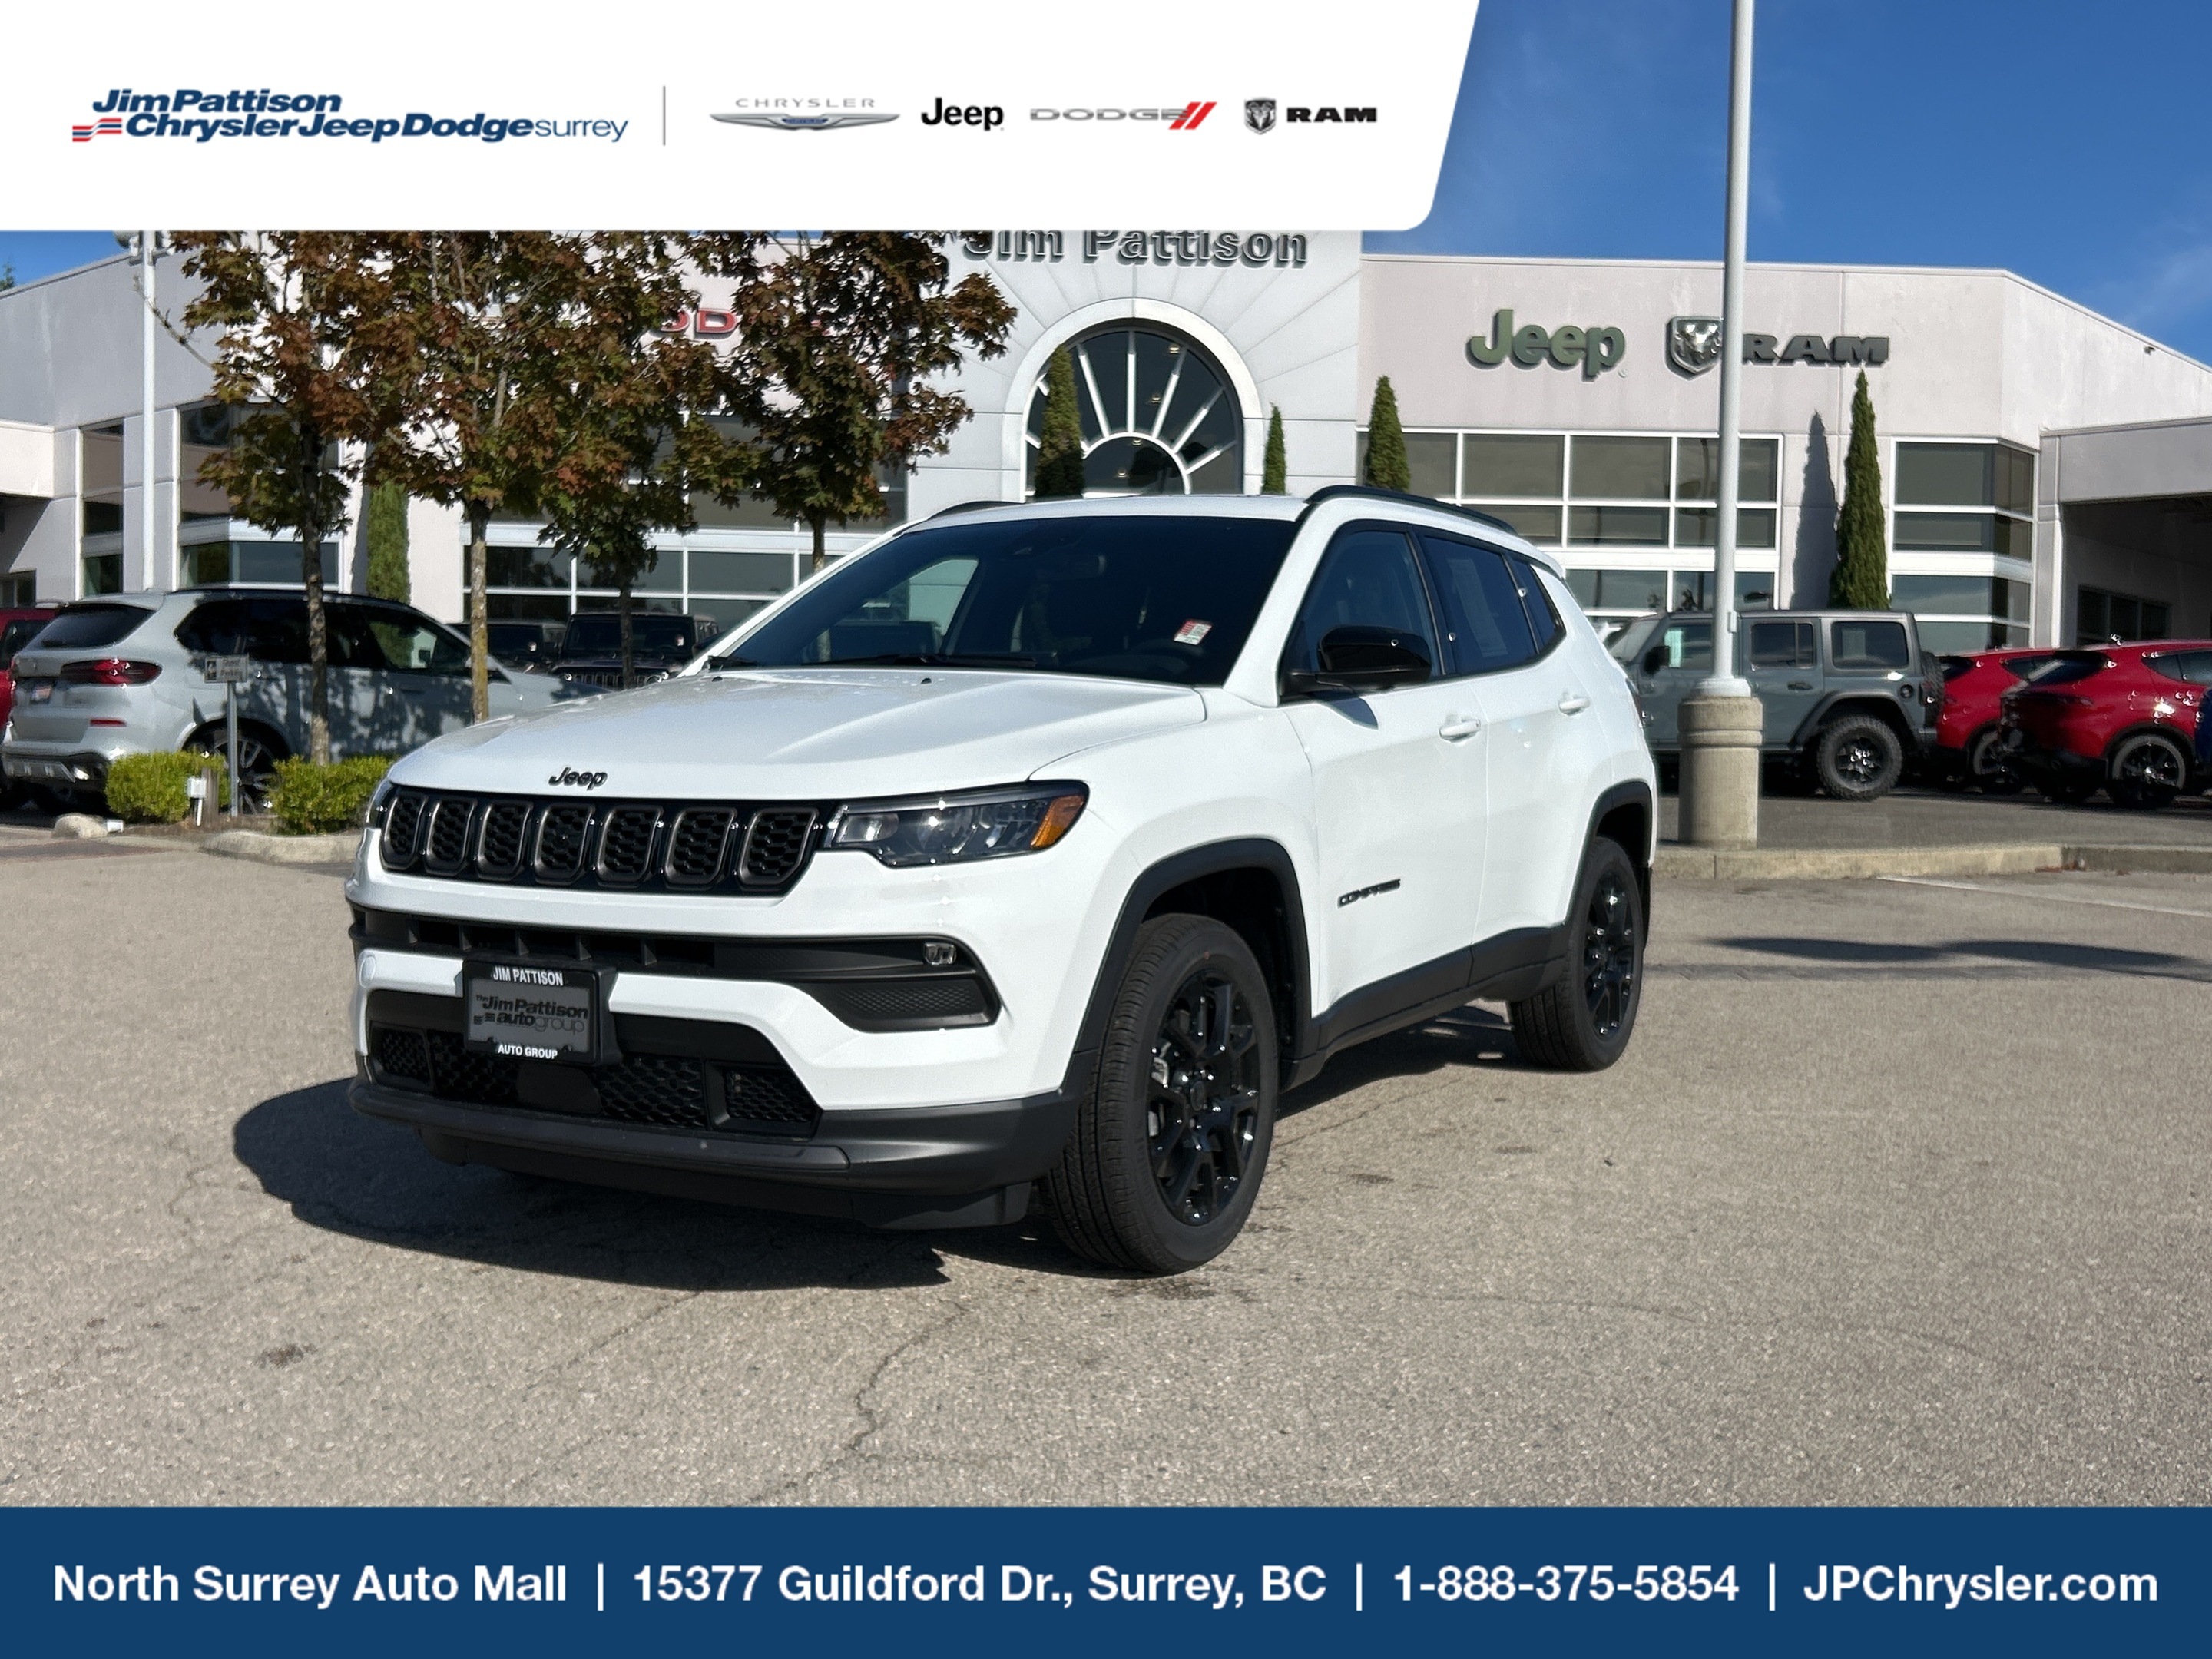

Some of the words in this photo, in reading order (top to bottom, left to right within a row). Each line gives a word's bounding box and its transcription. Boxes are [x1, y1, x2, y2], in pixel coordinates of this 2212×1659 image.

[1081, 230, 1309, 268] Pattison
[1466, 309, 1625, 382] Jeep
[1743, 333, 1889, 366] RAM
[548, 767, 608, 791] Jeep
[493, 966, 511, 982] JIM
[513, 969, 564, 986] PATTISON
[498, 1044, 523, 1056] AUTO
[525, 1047, 558, 1059] GROUP
